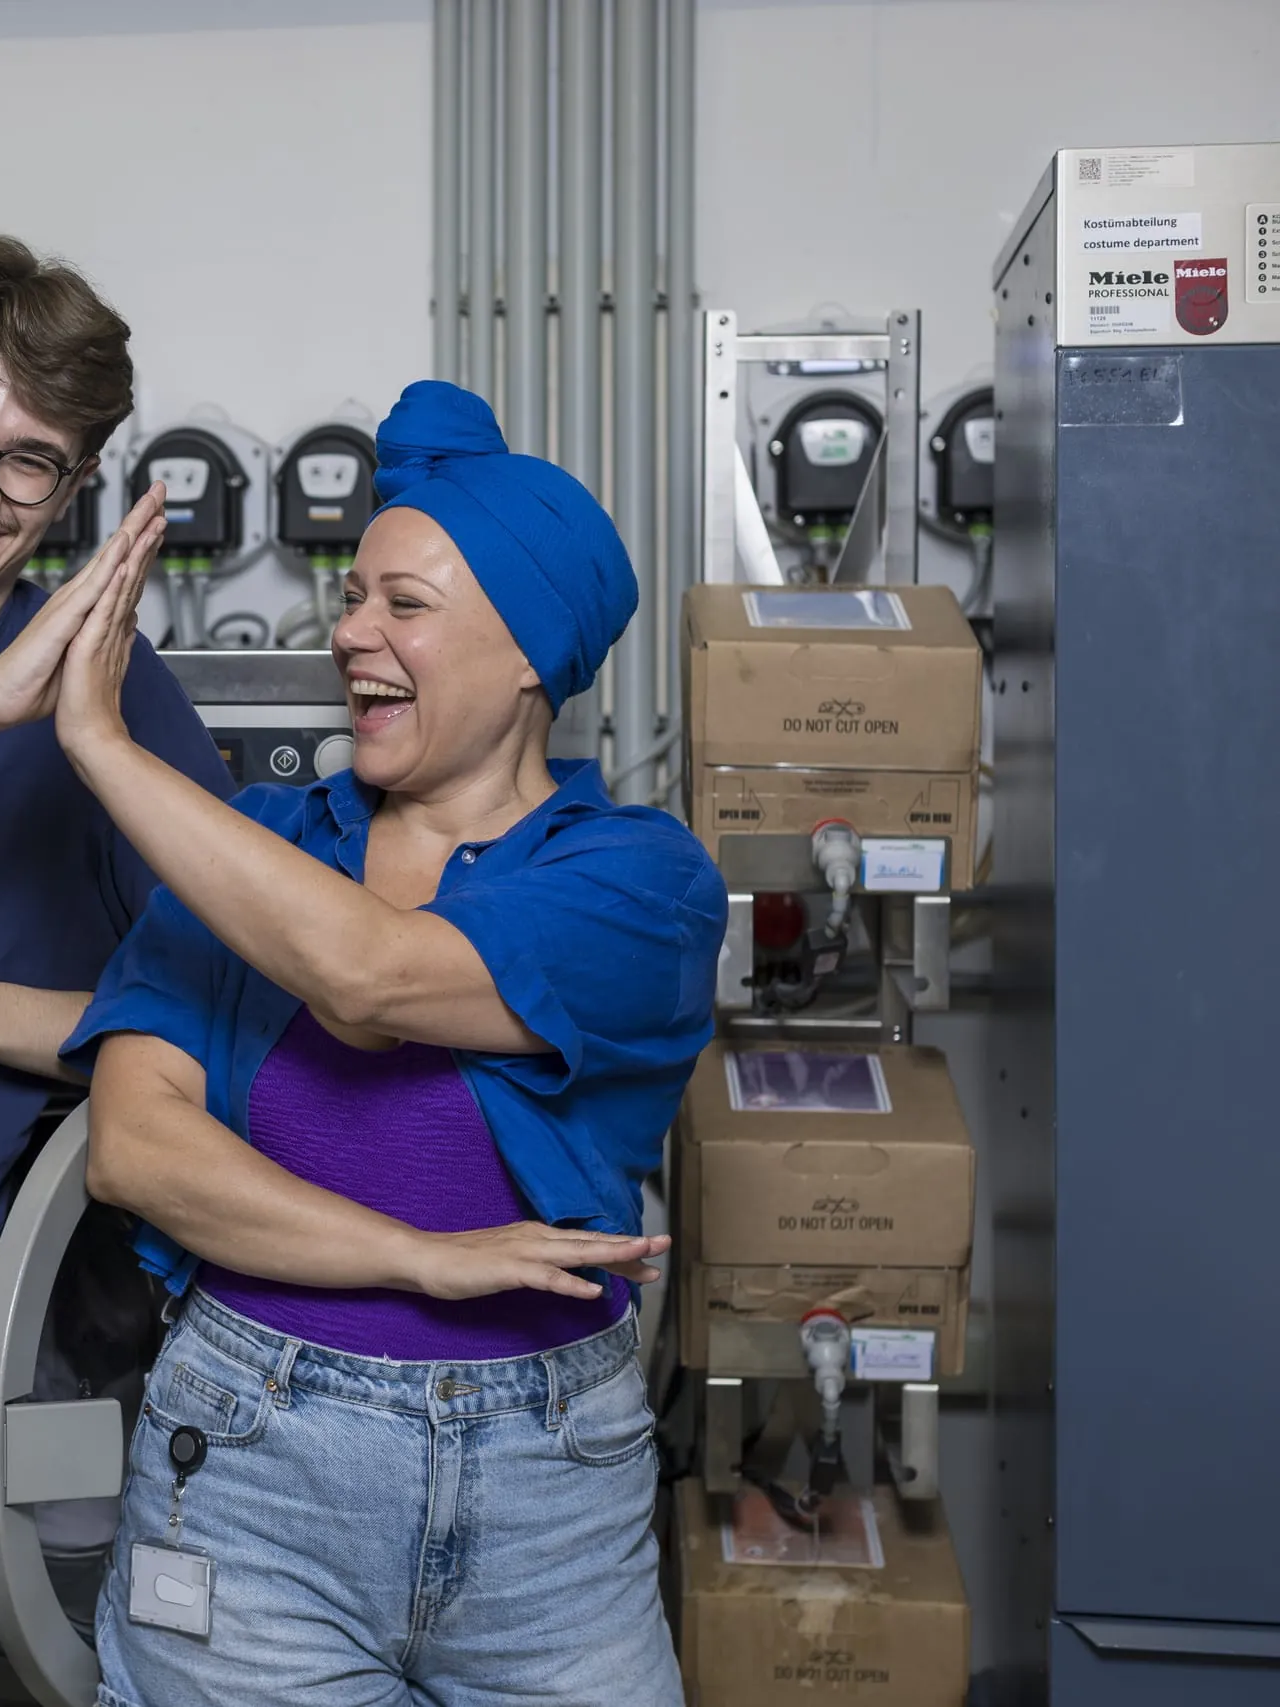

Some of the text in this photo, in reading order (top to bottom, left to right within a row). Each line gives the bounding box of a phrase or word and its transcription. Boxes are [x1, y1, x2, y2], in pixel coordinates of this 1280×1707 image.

[1084, 217, 1177, 229] Kostümabteilung
[1084, 237, 1199, 250] costume department
[1088, 270, 1169, 285] Miele
[1176, 267, 1226, 279] Miele
[1088, 288, 1169, 298] PROFESSIONAL
[783, 718, 899, 734] DO NOT CUT OPEN
[778, 1216, 893, 1231] DO NOT CUT OPEN
